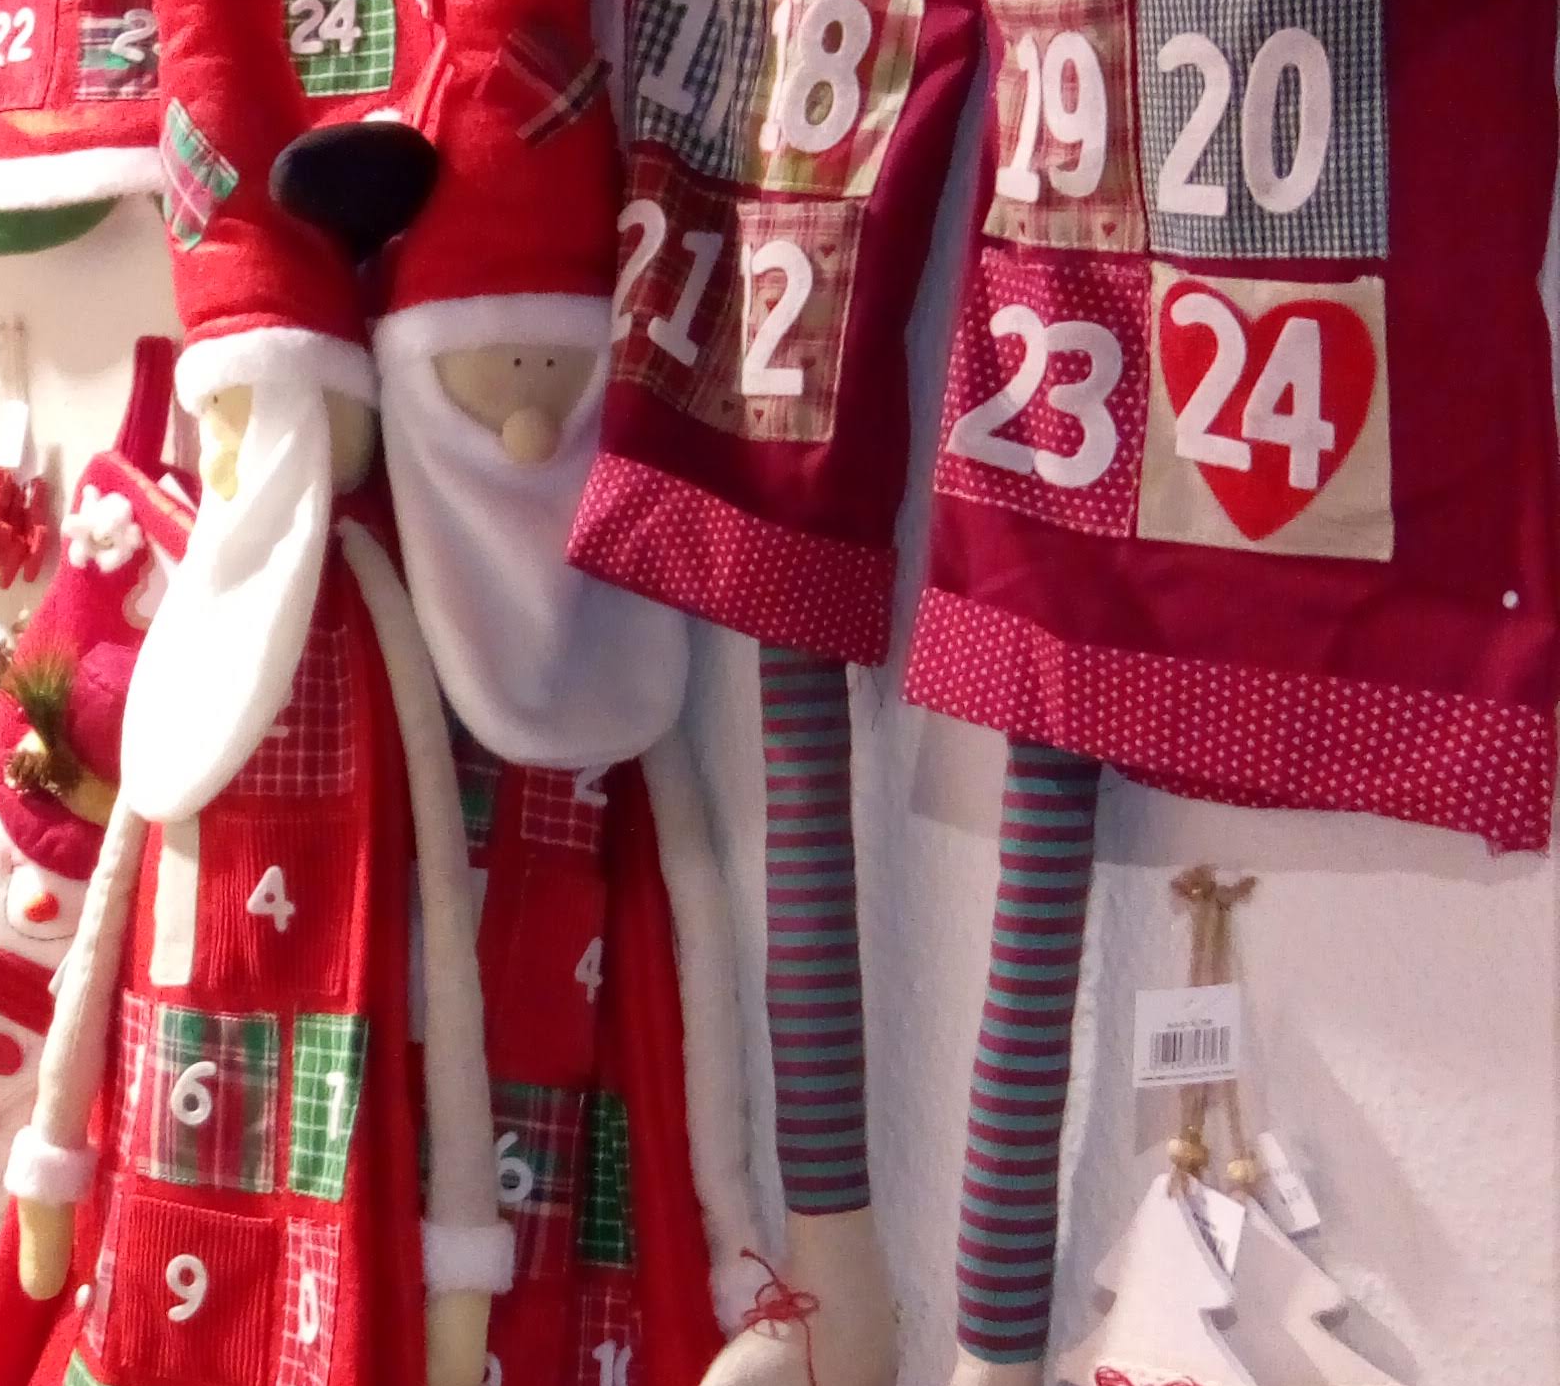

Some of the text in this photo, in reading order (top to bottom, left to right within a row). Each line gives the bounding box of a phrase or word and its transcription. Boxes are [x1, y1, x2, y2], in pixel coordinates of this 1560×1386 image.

[110, 8, 160, 62] 2
[995, 31, 1109, 201] 19
[1157, 29, 1332, 213] 20
[610, 199, 723, 366] 21
[944, 304, 1124, 488] 23
[1170, 292, 1335, 491] 24
[246, 865, 297, 933] 4
[574, 936, 604, 1005] 4
[170, 1061, 218, 1126] 6
[494, 1131, 534, 1204] 6
[165, 1254, 209, 1322] 9
